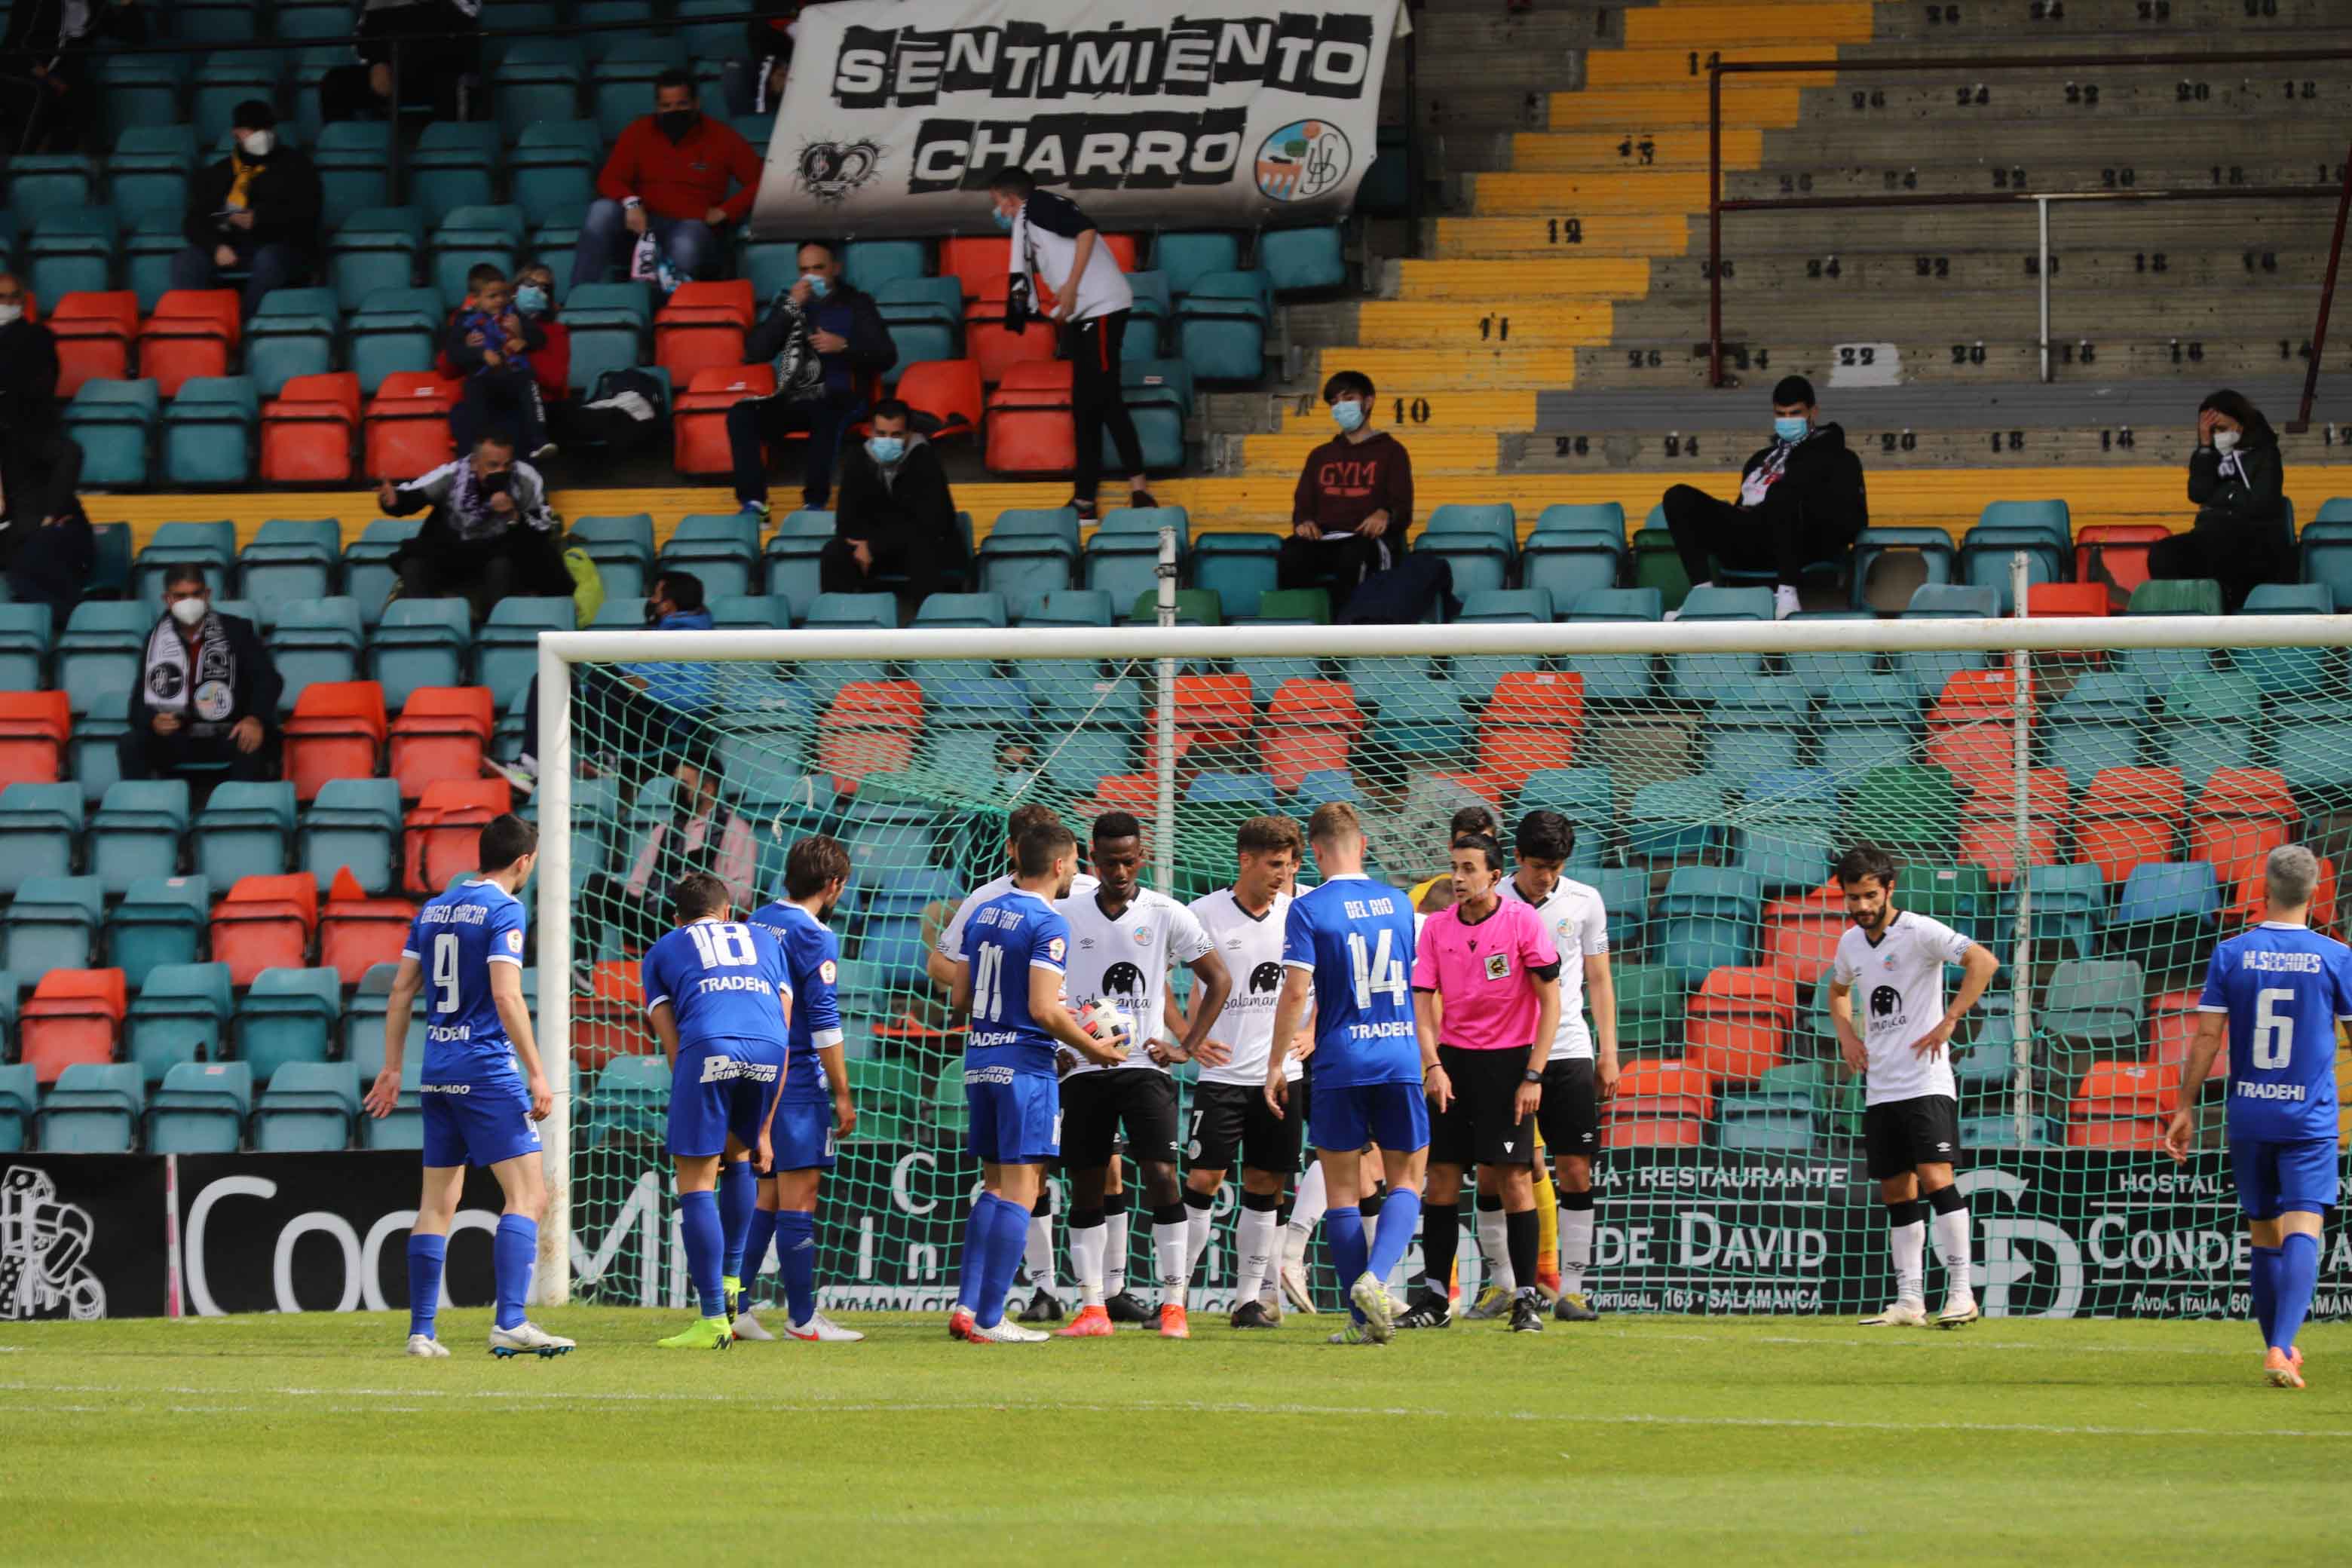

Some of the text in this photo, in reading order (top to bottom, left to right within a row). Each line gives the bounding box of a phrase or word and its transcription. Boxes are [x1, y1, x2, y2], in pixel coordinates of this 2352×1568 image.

[835, 23, 1369, 93] SENTIMIENTO
[914, 124, 1244, 182] CHARRO
[1394, 397, 1431, 424] 10
[421, 905, 452, 924] DIEGO
[1344, 897, 1394, 919] DEL RIO
[684, 923, 758, 969] 18
[433, 933, 459, 1013] 9
[972, 940, 1004, 1023] 11
[1347, 929, 1408, 1009] 14
[698, 977, 771, 995] TRADEHI
[1349, 1021, 1414, 1039] TRADEHI
[2252, 988, 2295, 1070] 6
[2237, 1081, 2306, 1101] TRADEHI
[1191, 1110, 1204, 1136] 7
[1640, 1167, 1848, 1189] RESTAURANTE
[2119, 1174, 2223, 1194] HOSTAL
[1680, 1211, 1827, 1268] DAVID
[2088, 1215, 2251, 1271] CONDE
[1582, 1288, 1658, 1310] PORTUGAL,
[1708, 1289, 1823, 1309] SALAMANCA
[2132, 1291, 2174, 1312] AVDA.
[2180, 1292, 2225, 1315] ITALIA,
